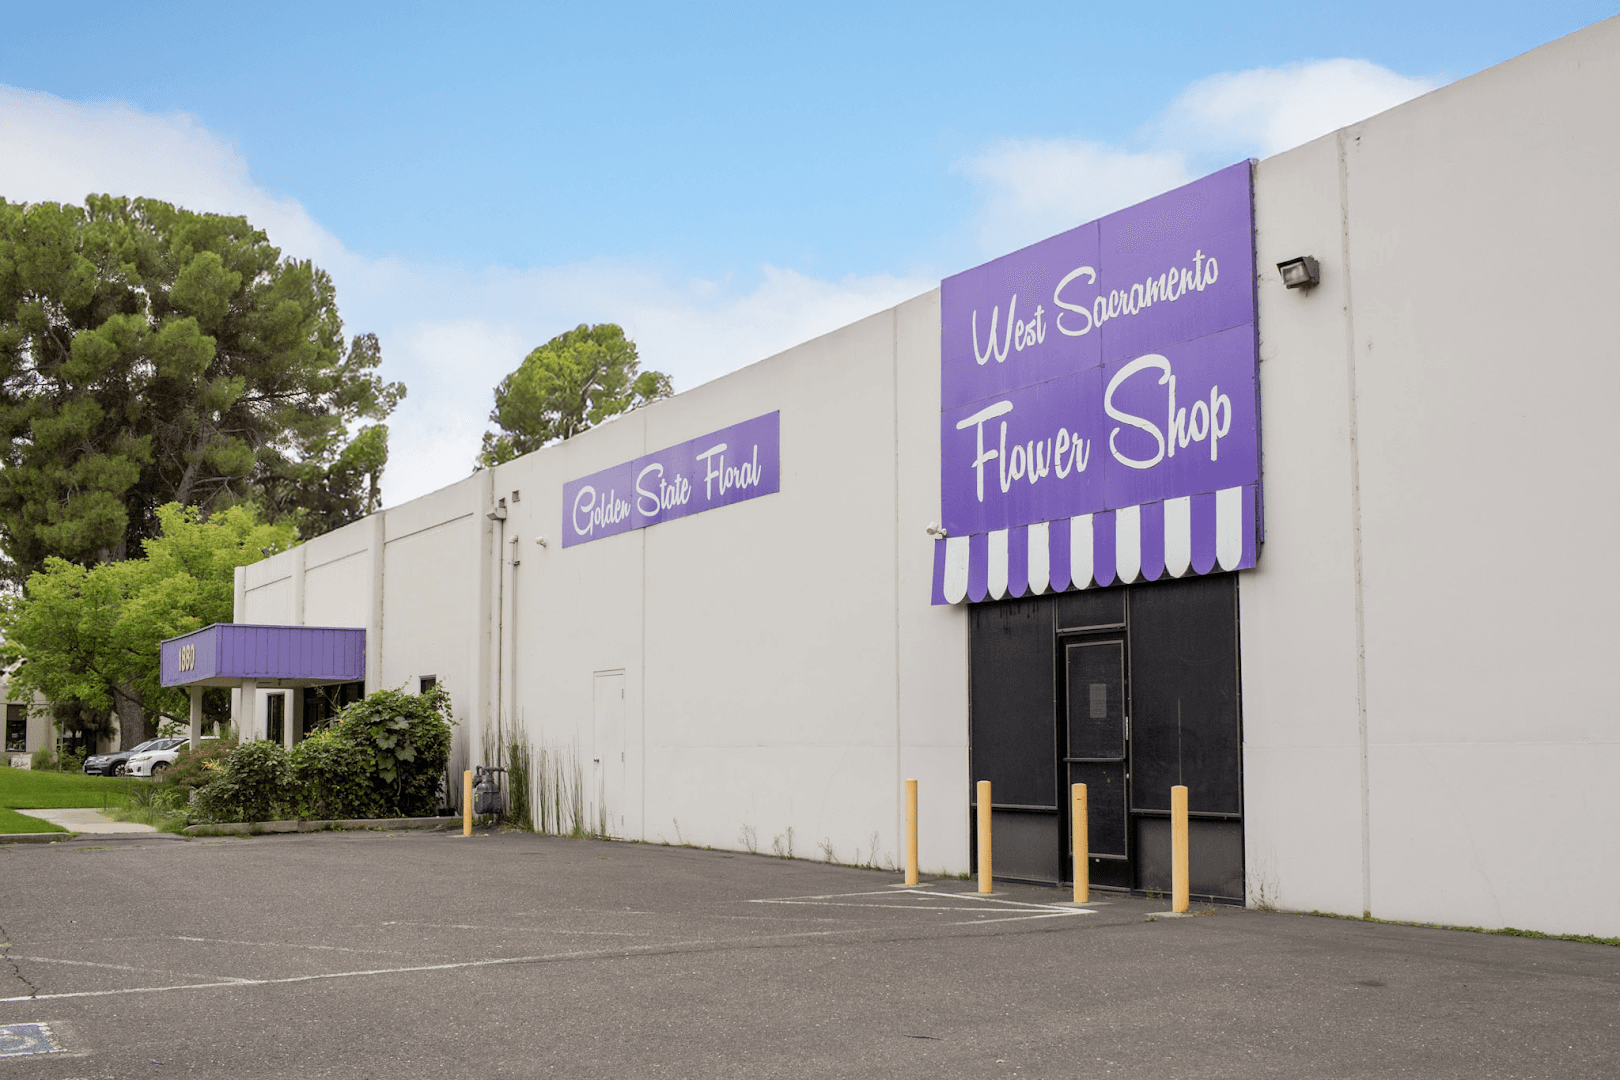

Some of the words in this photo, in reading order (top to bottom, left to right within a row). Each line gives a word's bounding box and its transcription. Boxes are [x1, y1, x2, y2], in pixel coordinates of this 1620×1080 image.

[972, 294, 1046, 366] West
[1053, 250, 1218, 337] Sacramento
[955, 400, 1091, 502] Flower
[1104, 354, 1231, 470] Shop
[573, 485, 631, 535] Golden
[636, 463, 691, 517] State
[696, 443, 761, 500] Floral
